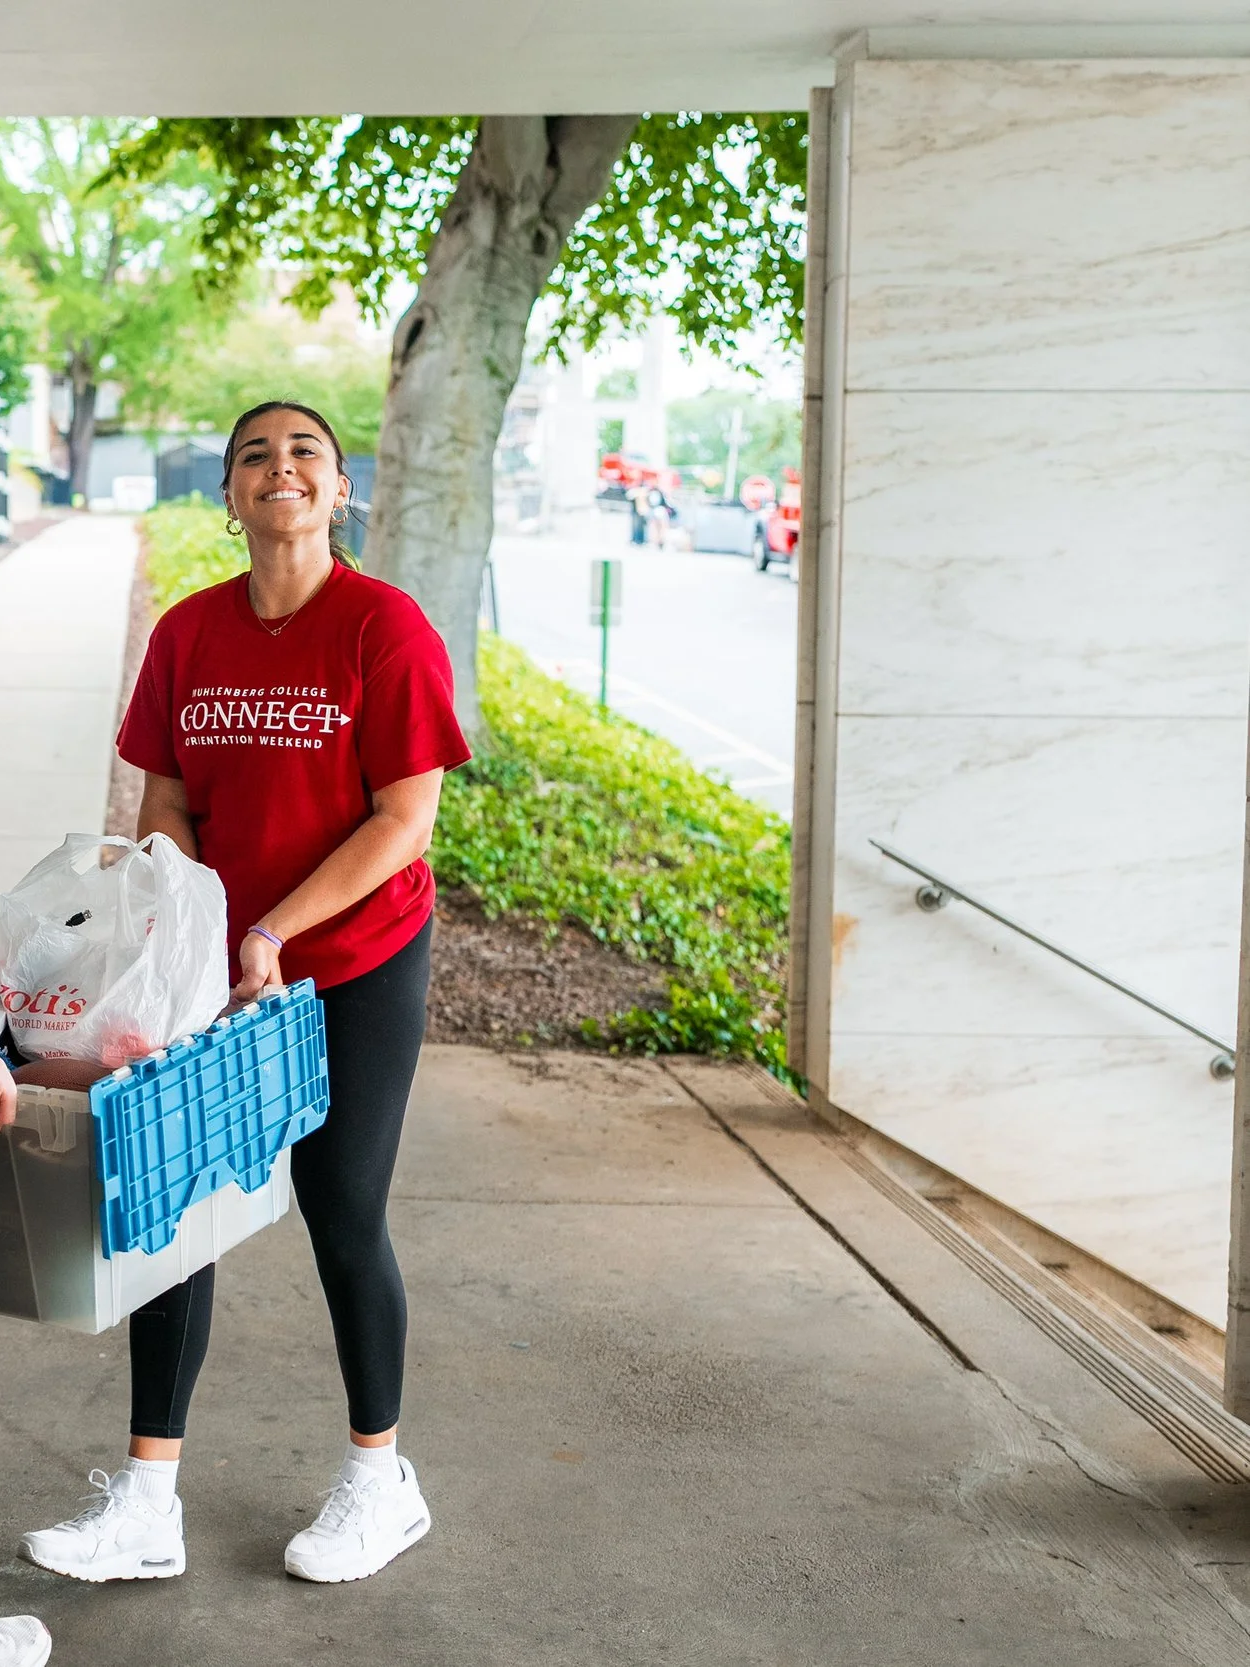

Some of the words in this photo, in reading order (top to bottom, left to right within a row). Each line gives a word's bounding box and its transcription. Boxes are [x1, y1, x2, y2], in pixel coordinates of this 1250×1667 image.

[192, 686, 265, 697] MUHLENBERG
[269, 686, 328, 698] COLLEGE
[180, 701, 339, 733] CONNECT
[185, 735, 253, 747] ORIENTATION
[259, 735, 323, 749] WEEKEND
[11, 1017, 42, 1029] WORLD
[44, 1020, 76, 1031] MARKET
